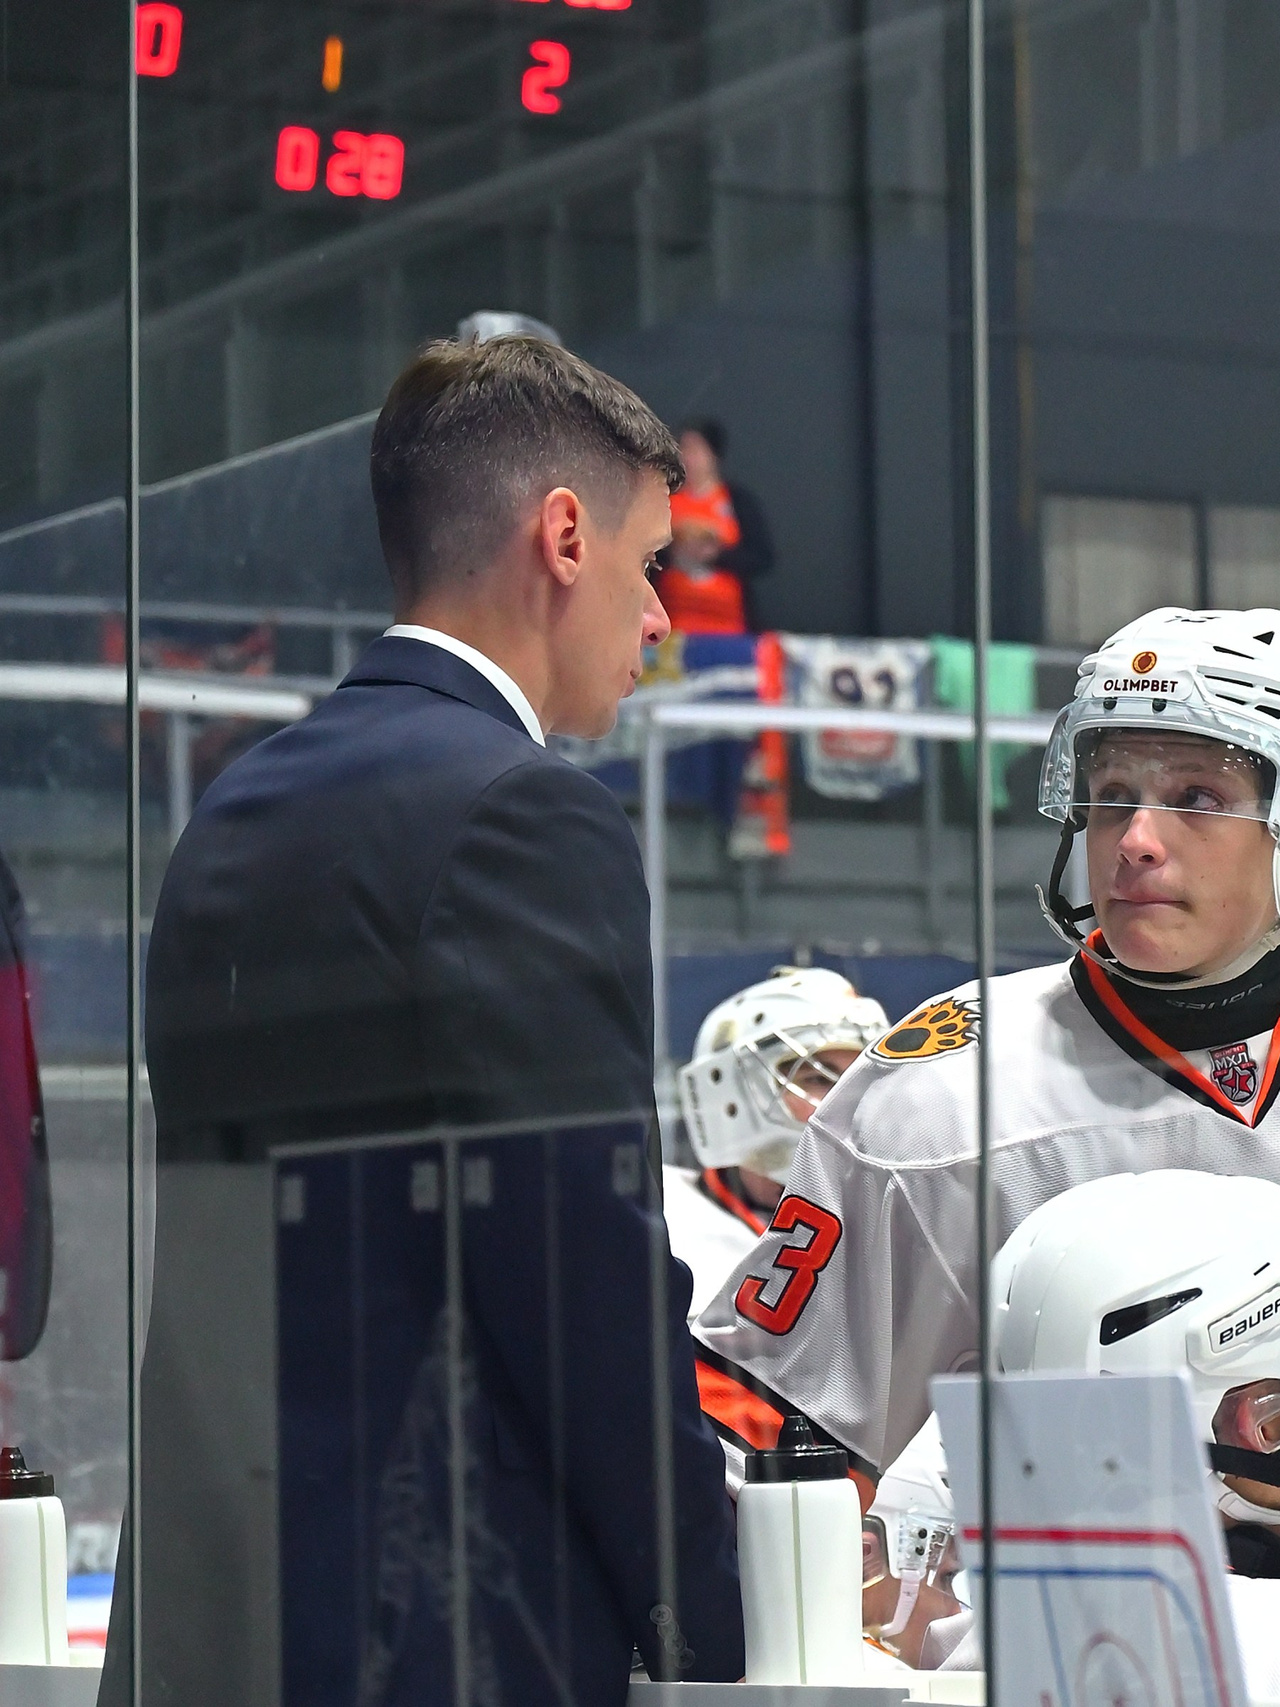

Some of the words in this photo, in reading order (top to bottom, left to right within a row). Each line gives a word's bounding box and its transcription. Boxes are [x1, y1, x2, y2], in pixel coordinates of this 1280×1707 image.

[136, 3, 183, 77] 0
[522, 40, 570, 114] 2
[1103, 678, 1178, 693] OLIMPBET
[1214, 1052, 1249, 1071] МХЛ
[734, 1194, 843, 1336] 3
